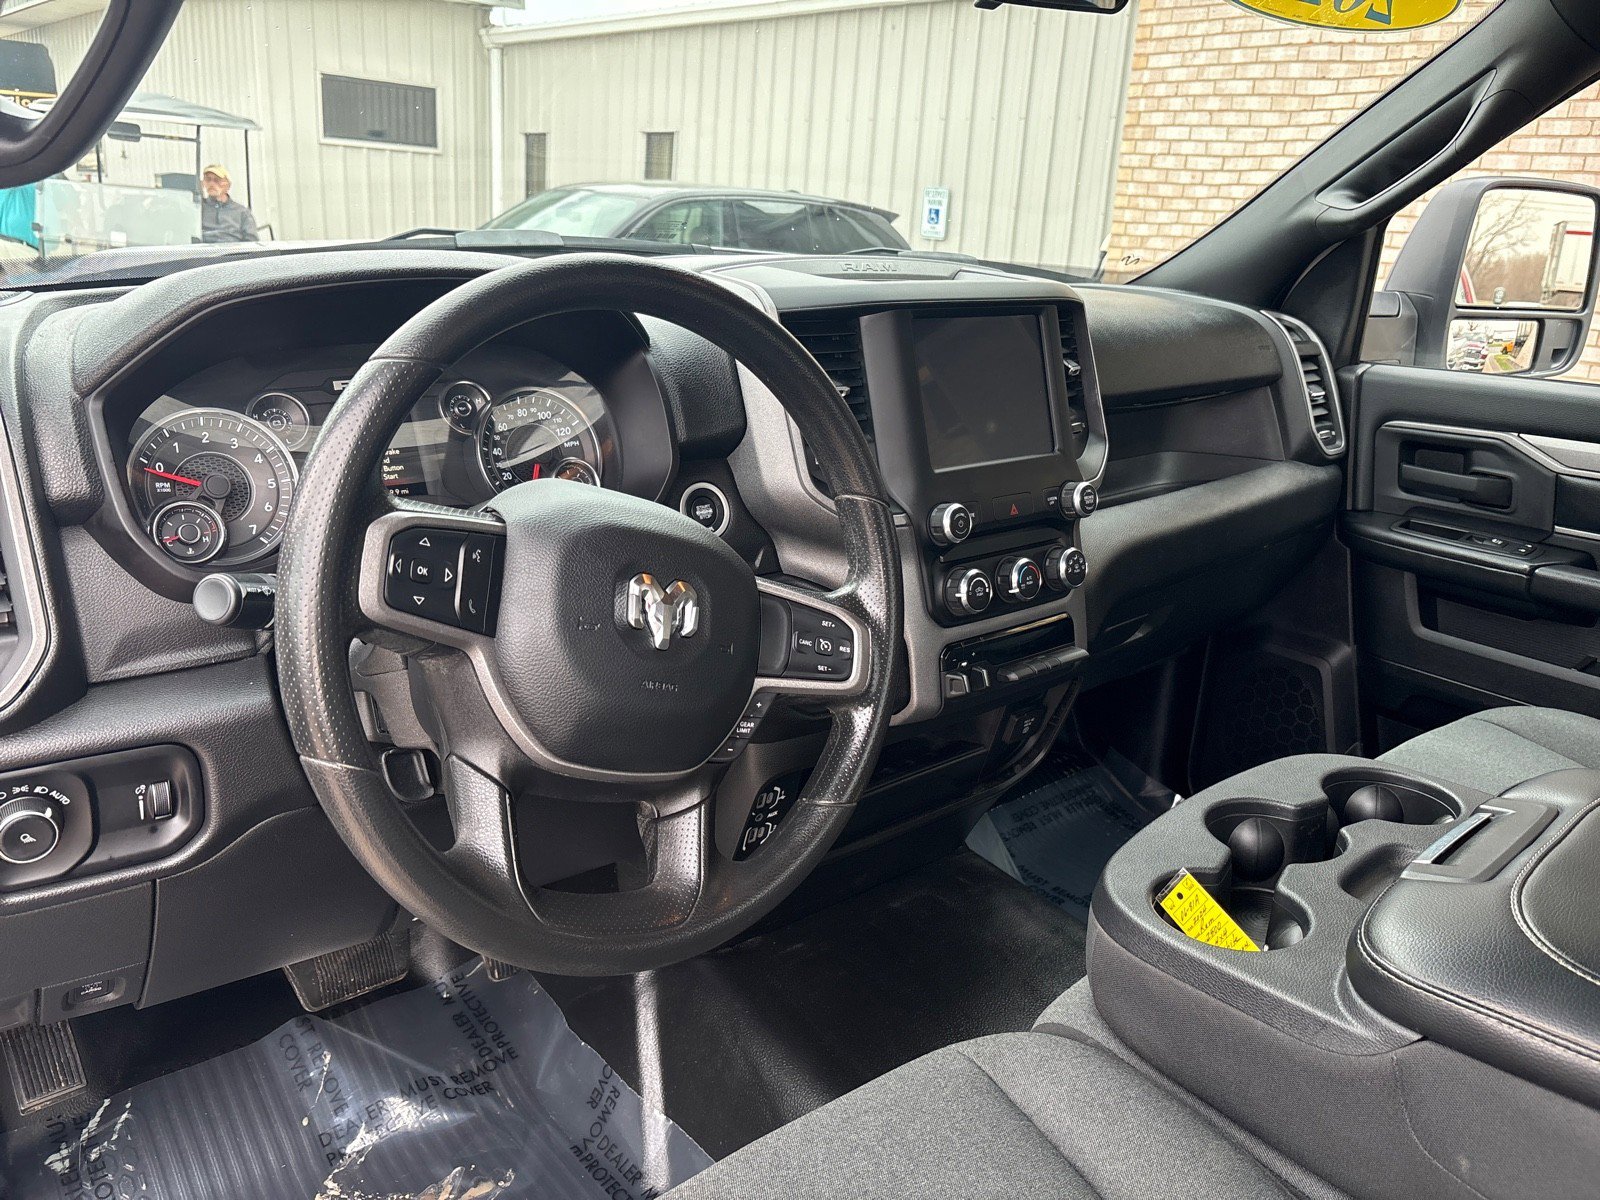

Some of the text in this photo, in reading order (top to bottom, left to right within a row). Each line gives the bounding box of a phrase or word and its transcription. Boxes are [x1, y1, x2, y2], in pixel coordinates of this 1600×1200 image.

[840, 262, 898, 273] RAM
[517, 408, 528, 417] 80
[537, 411, 552, 420] 100
[498, 422, 508, 431] 60
[555, 426, 571, 437] 120
[201, 431, 210, 443] 2
[172, 442, 180, 453] 1
[230, 437, 239, 449] 3
[563, 440, 580, 448] MPH
[384, 448, 400, 456] rake
[492, 447, 502, 456] 40
[254, 453, 264, 464] 4
[155, 462, 164, 473] 0
[383, 464, 405, 472] Button
[383, 473, 399, 481] Start
[501, 472, 513, 481] 20
[267, 478, 276, 489] 5
[264, 502, 273, 512] 6
[248, 524, 257, 535] 7
[416, 566, 428, 577] OK
[799, 638, 813, 647] CANC
[839, 645, 851, 653] RES
[49, 790, 71, 806] AUTO
[450, 972, 512, 1049] PROTECTIVE
[280, 1033, 313, 1092] COVER
[443, 1081, 496, 1100] COVER
[587, 1064, 613, 1110] OVER
[318, 1047, 519, 1149] DEALER MUST REMOVE
[569, 1085, 621, 1157] REMOVE
[597, 1134, 644, 1186] DEALER
